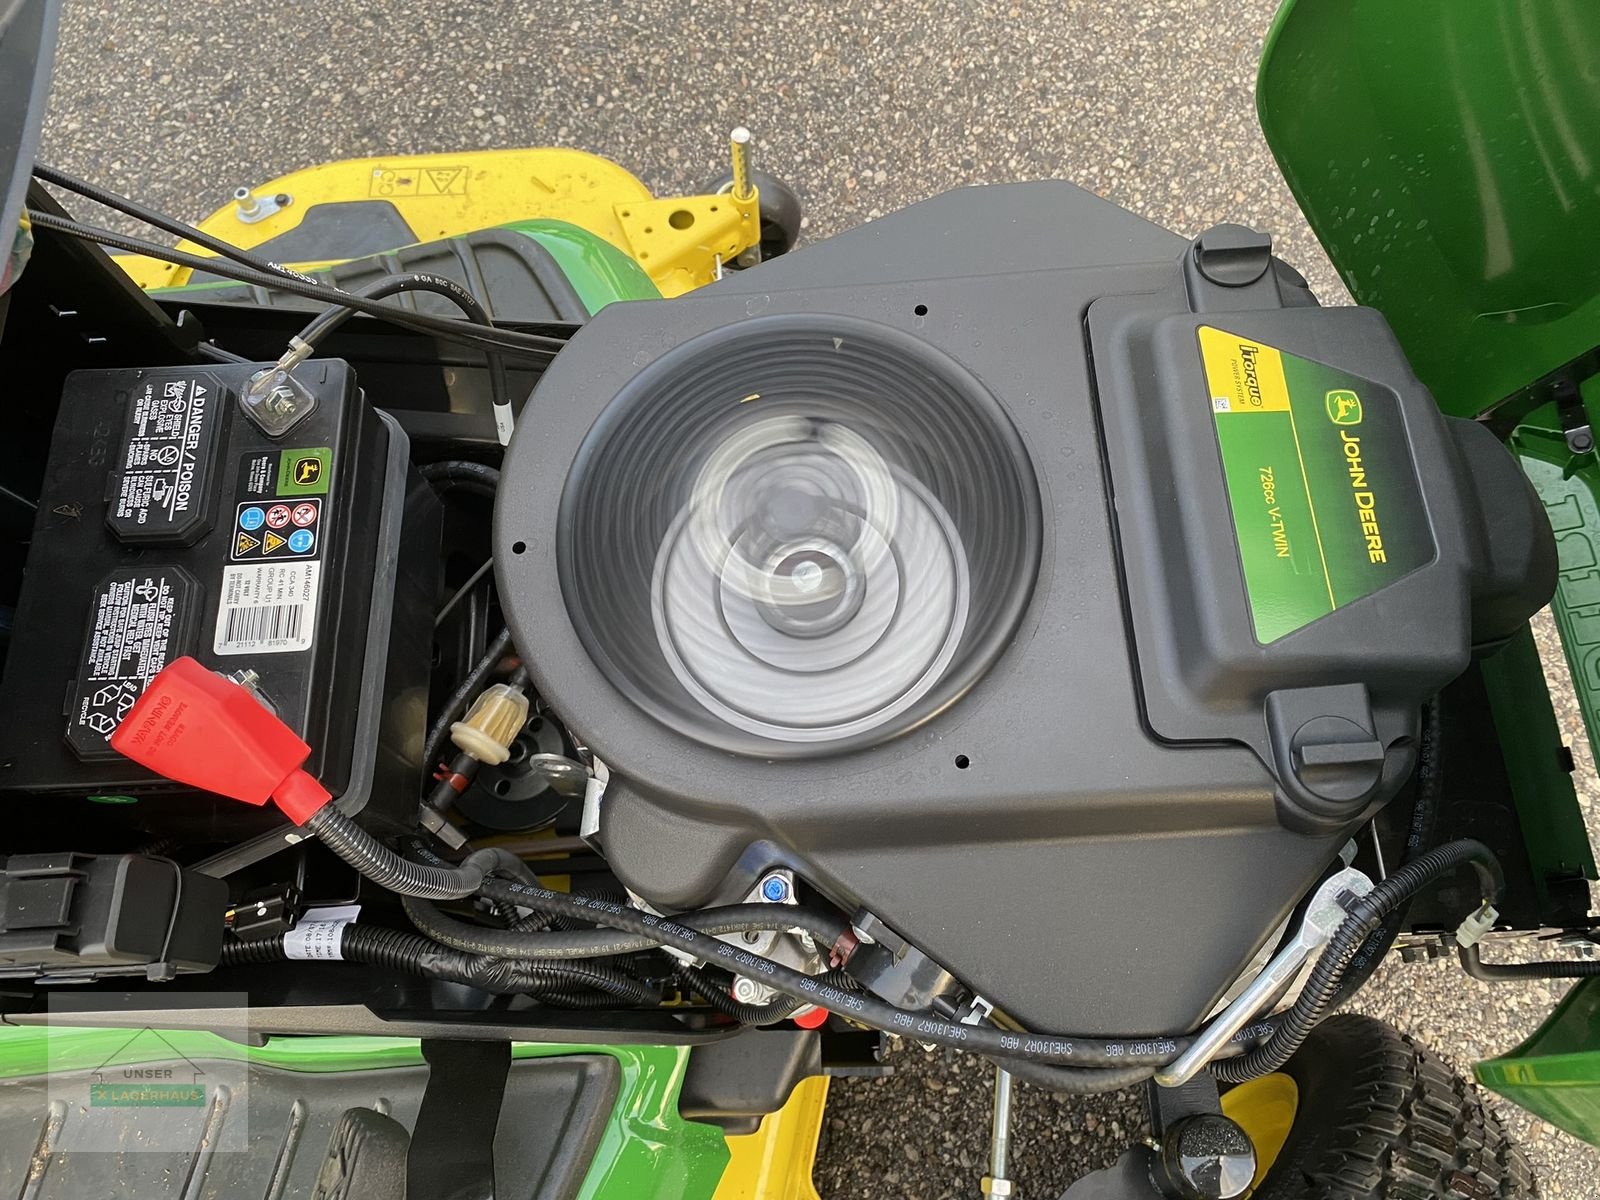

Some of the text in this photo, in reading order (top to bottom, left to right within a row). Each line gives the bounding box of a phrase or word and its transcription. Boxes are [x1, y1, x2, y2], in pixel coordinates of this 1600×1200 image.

[1230, 359, 1245, 405] POWER SYSTEM
[137, 398, 143, 408] OR
[149, 399, 159, 420] GASES
[155, 400, 168, 433] EXPLOSIVE
[164, 414, 173, 431] EYES
[172, 414, 182, 437] SHIELD
[186, 398, 205, 450] DANGER
[149, 450, 158, 460] NO
[120, 476, 130, 498] SEVERE
[124, 475, 138, 518] BLINDNESS OR
[133, 475, 145, 508] CAN CAUSE
[138, 475, 154, 524] SULFURIC ACID
[175, 462, 194, 511] POISON
[1340, 430, 1387, 563] JOHN DEERE
[1258, 466, 1290, 558] 726cc V-TWIN
[266, 567, 275, 595] GROUP
[279, 568, 285, 577] RC
[303, 564, 312, 601] AM146027
[100, 593, 108, 607] SEEK
[162, 585, 170, 595] DO
[139, 603, 148, 619] WITH
[108, 606, 120, 644] INSTRUCTIONS
[122, 604, 140, 661] MEDICAL HELP FAST
[155, 623, 164, 638] KEEP
[164, 627, 170, 637] OF
[99, 636, 108, 648] NOT
[132, 641, 142, 654] GET
[136, 603, 156, 676] FLUSH EYES IMMEDIATELY
[152, 640, 161, 656] VENT
[93, 649, 105, 676] AVAILABLE
[101, 652, 112, 674] VEHICLE
[108, 649, 121, 675] STARTING
[148, 656, 158, 674] CAPS
[155, 650, 166, 673] REACH
[122, 680, 138, 692] LEAD
[79, 696, 90, 725] RECYCLE
[131, 696, 172, 745] WARNING
[154, 732, 165, 746] NOT
[164, 702, 188, 732] REMOVE
[167, 723, 186, 748] COVER
[642, 914, 697, 941] SAEJ30R7 ABG
[717, 944, 776, 974] SAEJ30R7 ABG
[800, 977, 864, 1011] SAEJ30R7 ABG
[894, 1012, 967, 1040] SAEJ30R7 ABG
[1000, 1035, 1073, 1055] SAEJ30R7 ABG
[1105, 1040, 1176, 1057] SAEJ30R7 ABG
